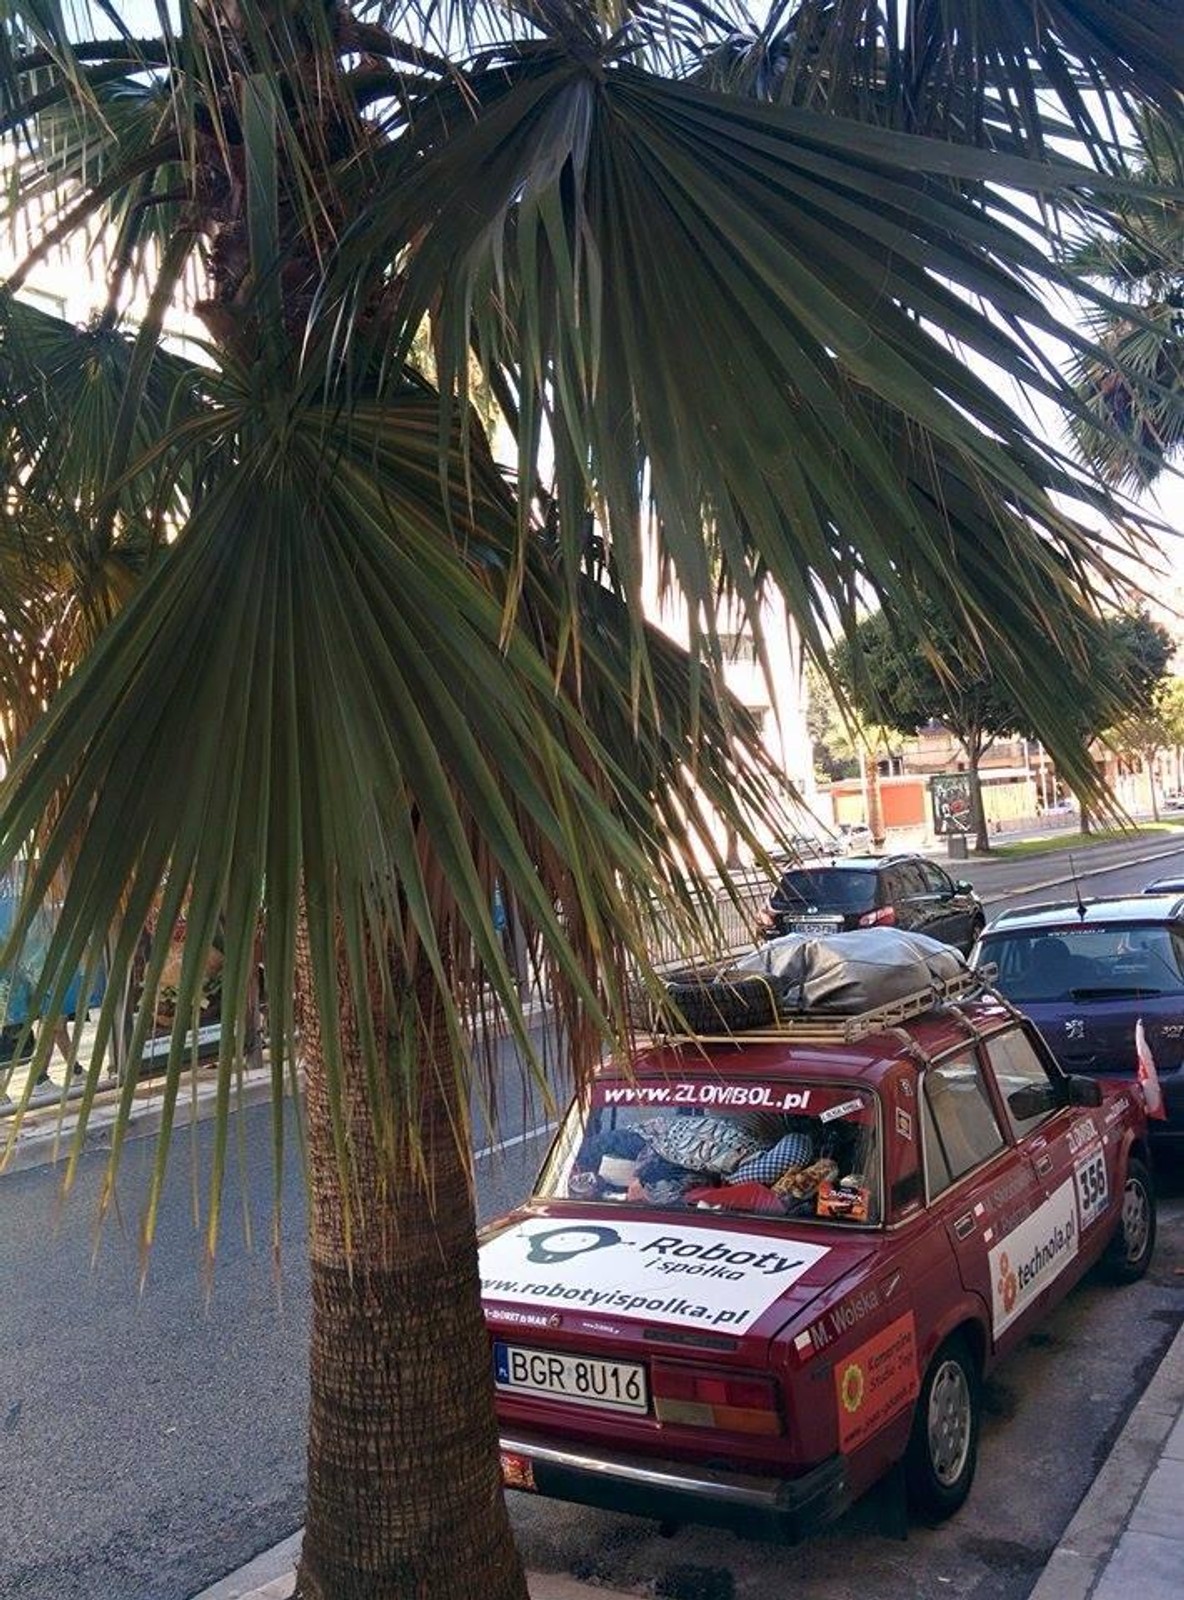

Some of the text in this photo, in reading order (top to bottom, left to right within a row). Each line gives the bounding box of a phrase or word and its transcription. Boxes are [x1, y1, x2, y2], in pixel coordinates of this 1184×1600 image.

[640, 1236, 804, 1275] Roboty
[644, 1257, 746, 1281] i spółka
[1017, 1209, 1075, 1289] technola.pl
[481, 1279, 751, 1326] ww.robotyispolka.pl
[810, 1291, 880, 1350] M. Wolska
[511, 1352, 641, 1401] BGR 8U16
